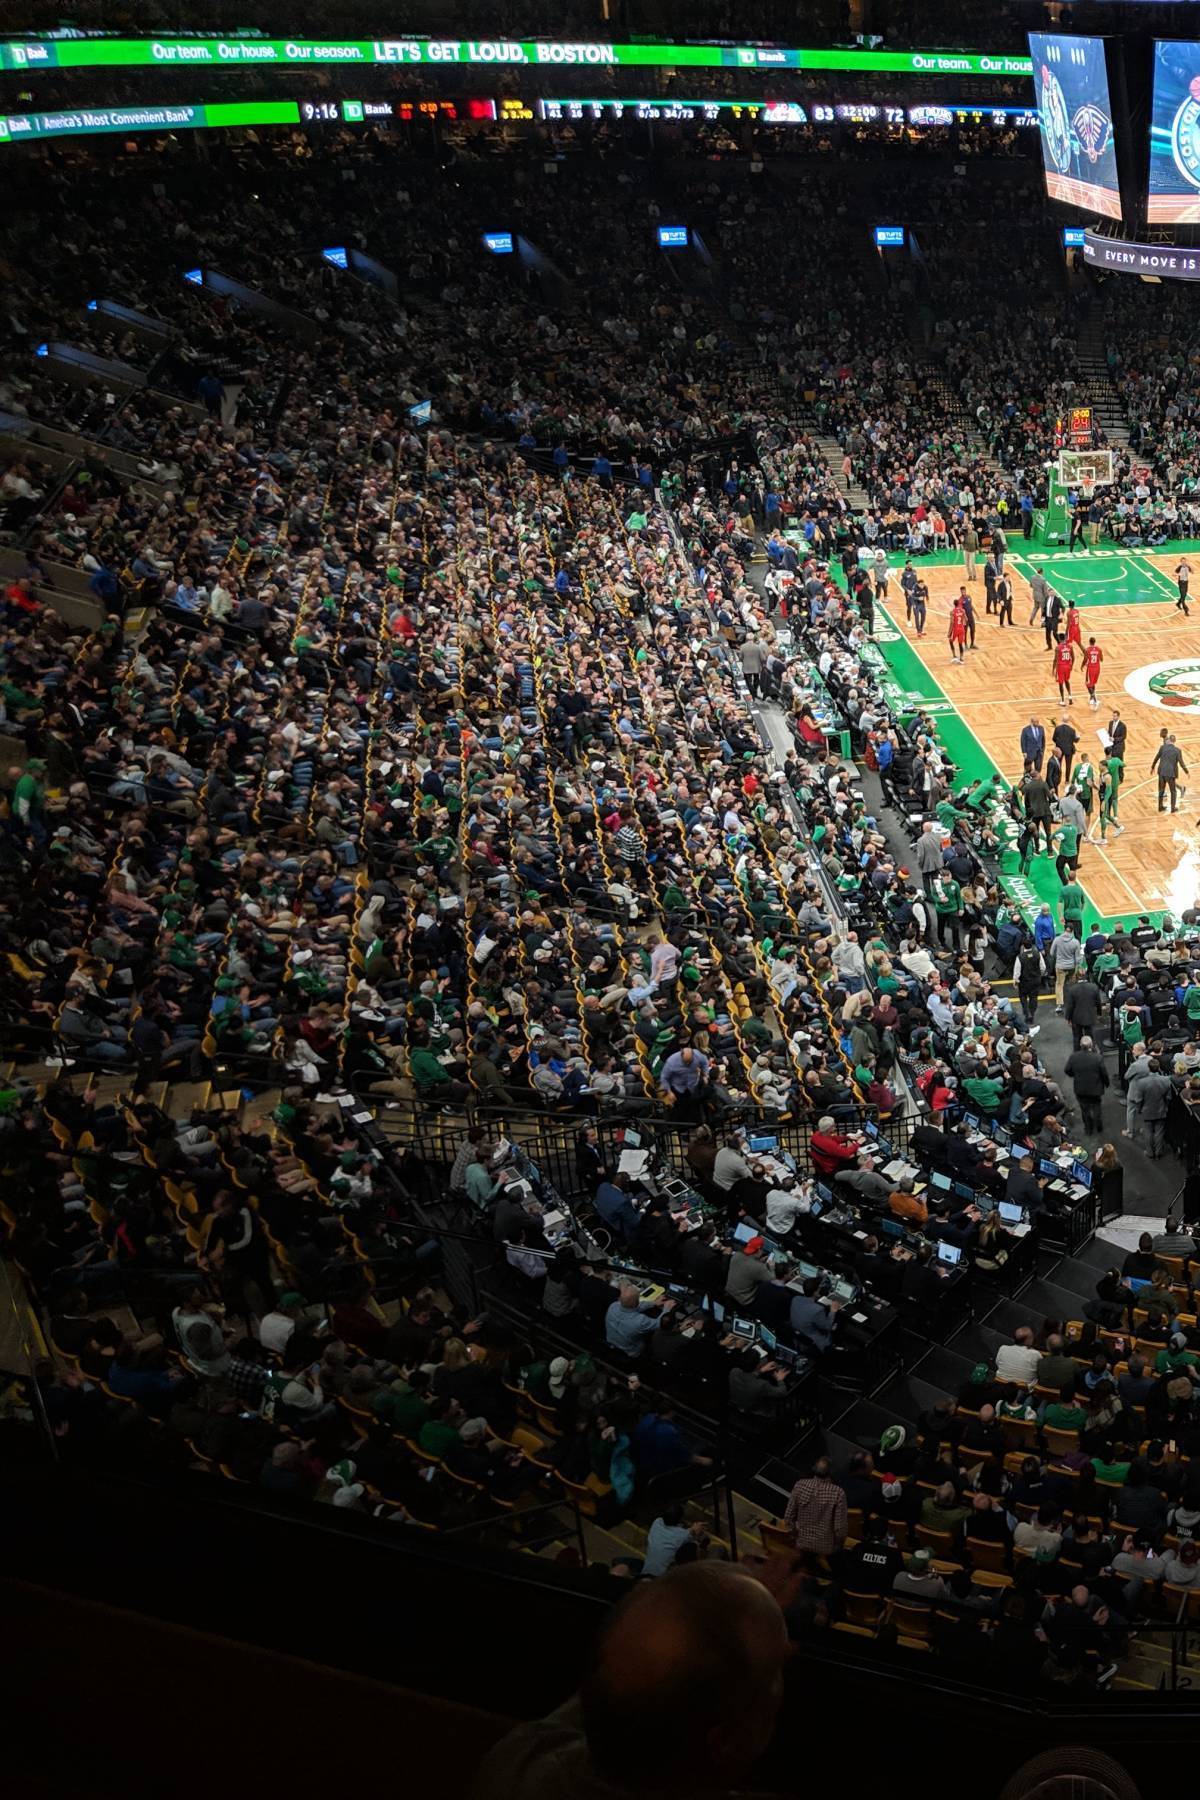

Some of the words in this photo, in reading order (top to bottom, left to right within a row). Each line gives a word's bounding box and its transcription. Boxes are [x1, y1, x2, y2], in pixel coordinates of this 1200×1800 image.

[27, 47, 48, 59] Bank
[153, 42, 176, 59] Our
[176, 44, 212, 59] team.
[218, 43, 239, 58] Our
[240, 43, 278, 58] house.
[286, 43, 311, 58] Our
[313, 46, 364, 58] season.
[374, 42, 421, 61] LET'S
[428, 43, 461, 61] GET
[469, 44, 529, 63] LOUD,
[536, 44, 619, 62] BOSTON.
[758, 52, 785, 63] Bank
[913, 56, 937, 69] Our
[938, 58, 972, 69] team.
[980, 57, 1000, 70] Our
[305, 104, 338, 119] 9:16
[364, 103, 393, 114] Bank
[549, 110, 563, 119] 41
[572, 110, 583, 119] 16
[815, 107, 834, 121] 83
[843, 106, 876, 117] 12:00
[706, 111, 718, 119] 47
[886, 109, 904, 122] 72
[993, 117, 1005, 125] 42
[9, 119, 31, 132] Bank
[44, 115, 82, 130] America's
[82, 113, 111, 126] Most
[112, 111, 165, 125] Convenient
[1105, 250, 1135, 264] EVERY
[1140, 252, 1177, 268] MOVE
[1183, 258, 1195, 269] IS
[1073, 418, 1088, 431] 24
[863, 1553, 888, 1565] CELTICS
